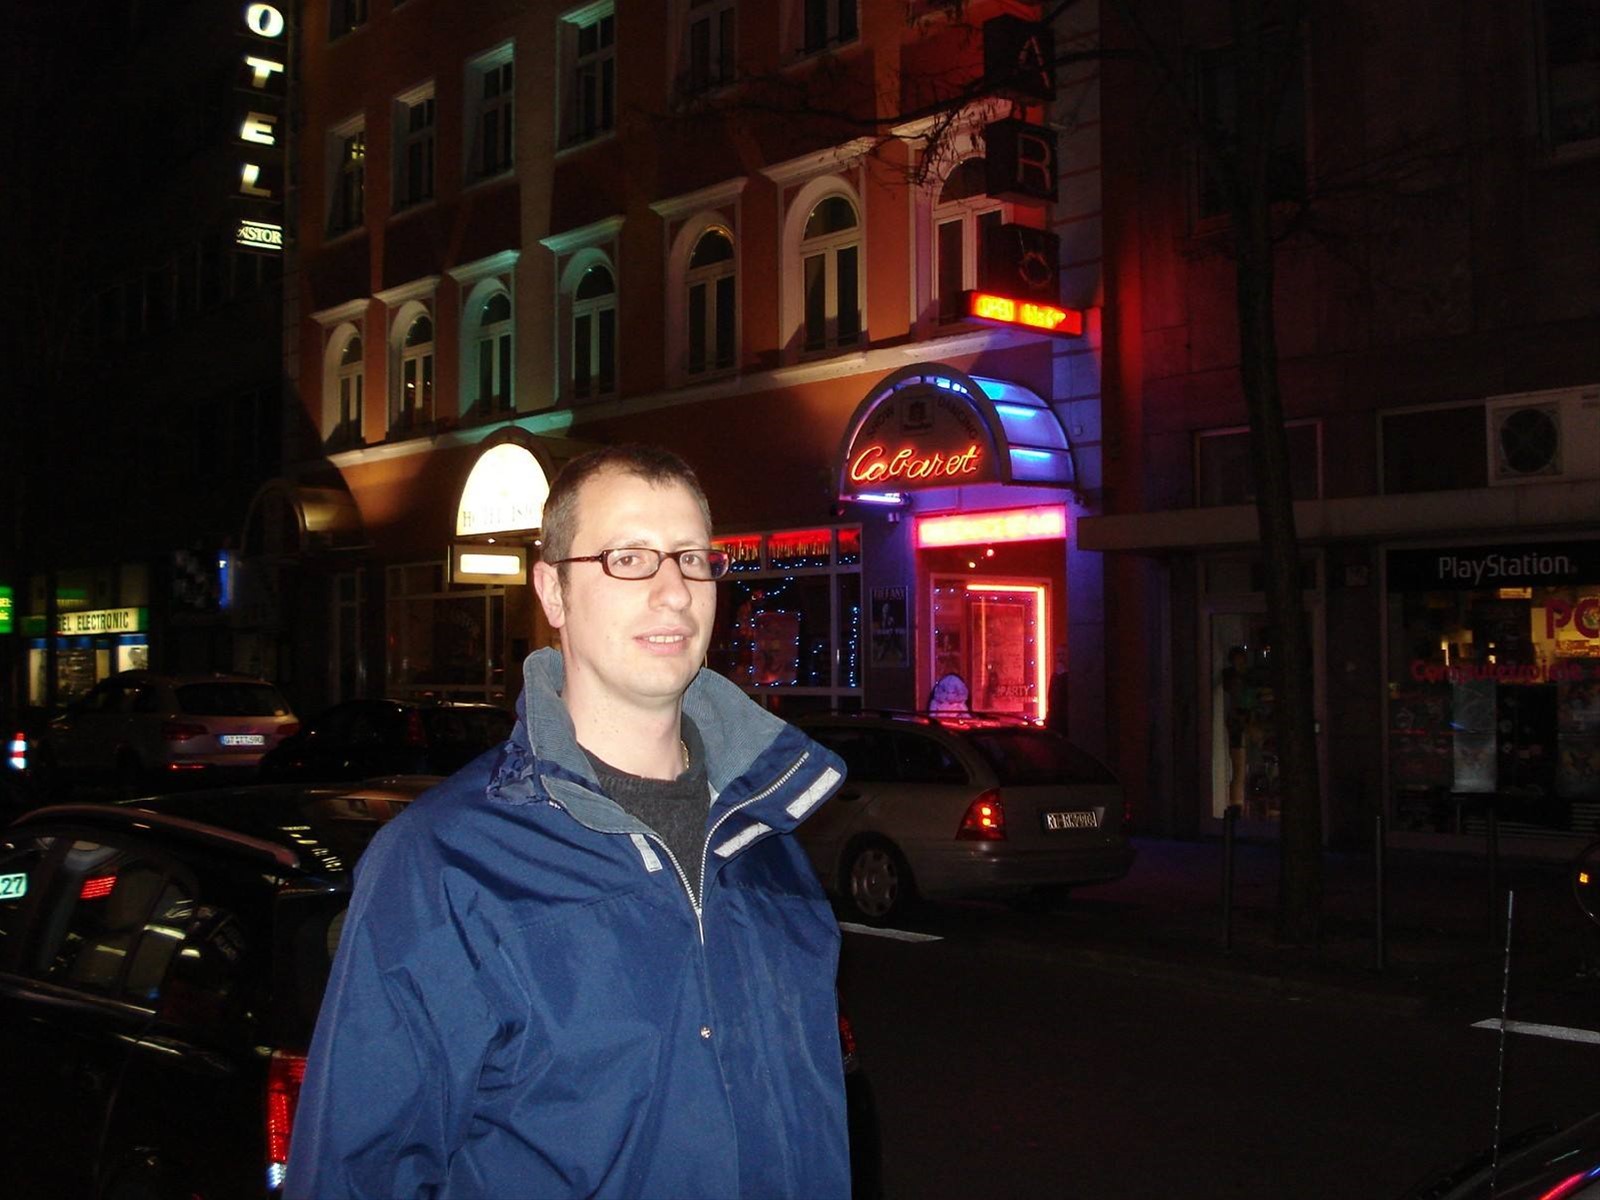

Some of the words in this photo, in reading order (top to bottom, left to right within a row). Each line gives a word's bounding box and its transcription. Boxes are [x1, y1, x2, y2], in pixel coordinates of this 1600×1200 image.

[237, 225, 282, 245] ASTOR
[851, 444, 980, 482] Cabaret
[1438, 553, 1570, 586] PlayStation
[77, 612, 129, 631] ELECTRONIC
